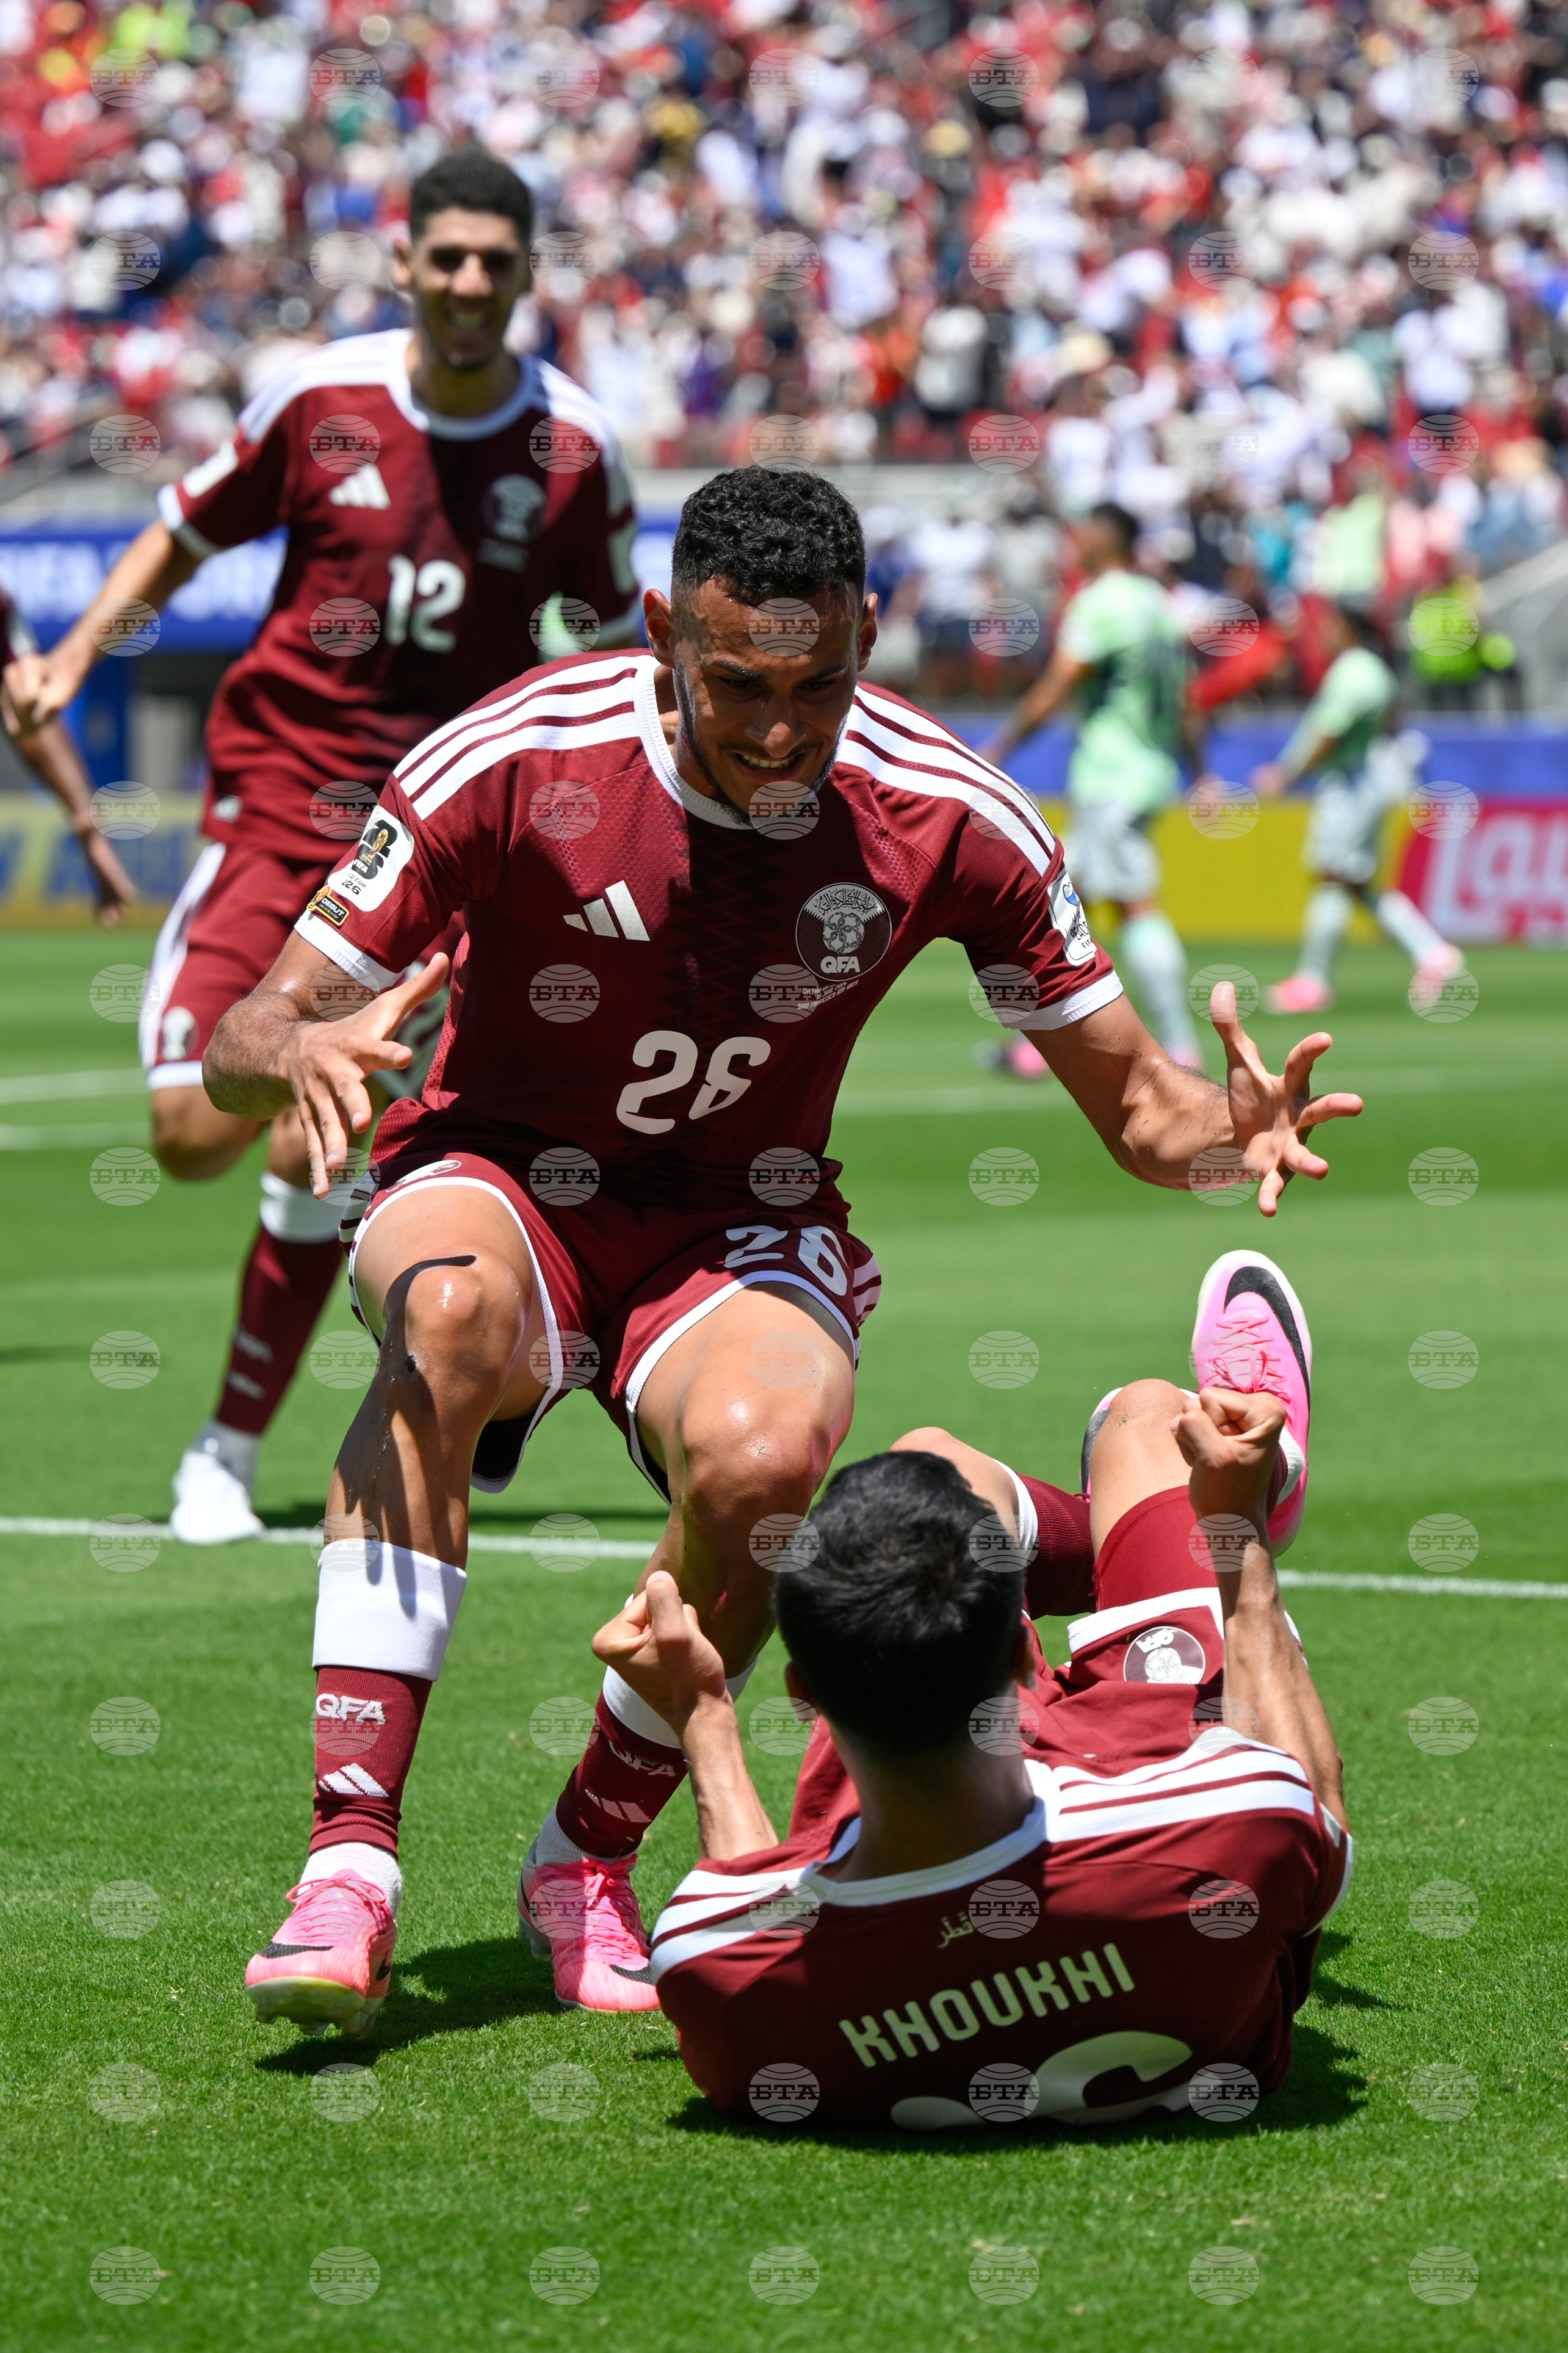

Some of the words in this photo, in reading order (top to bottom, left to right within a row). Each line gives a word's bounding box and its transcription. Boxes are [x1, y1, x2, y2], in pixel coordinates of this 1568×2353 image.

[385, 554, 466, 653] 12
[352, 858, 369, 874] FIFA
[321, 897, 345, 916] DEBUT
[820, 955, 861, 974] QFA
[616, 1029, 771, 1135] 26
[723, 1225, 848, 1296] 26
[316, 1693, 386, 1725] QFA
[839, 1943, 1135, 2068] KHOUKHI
